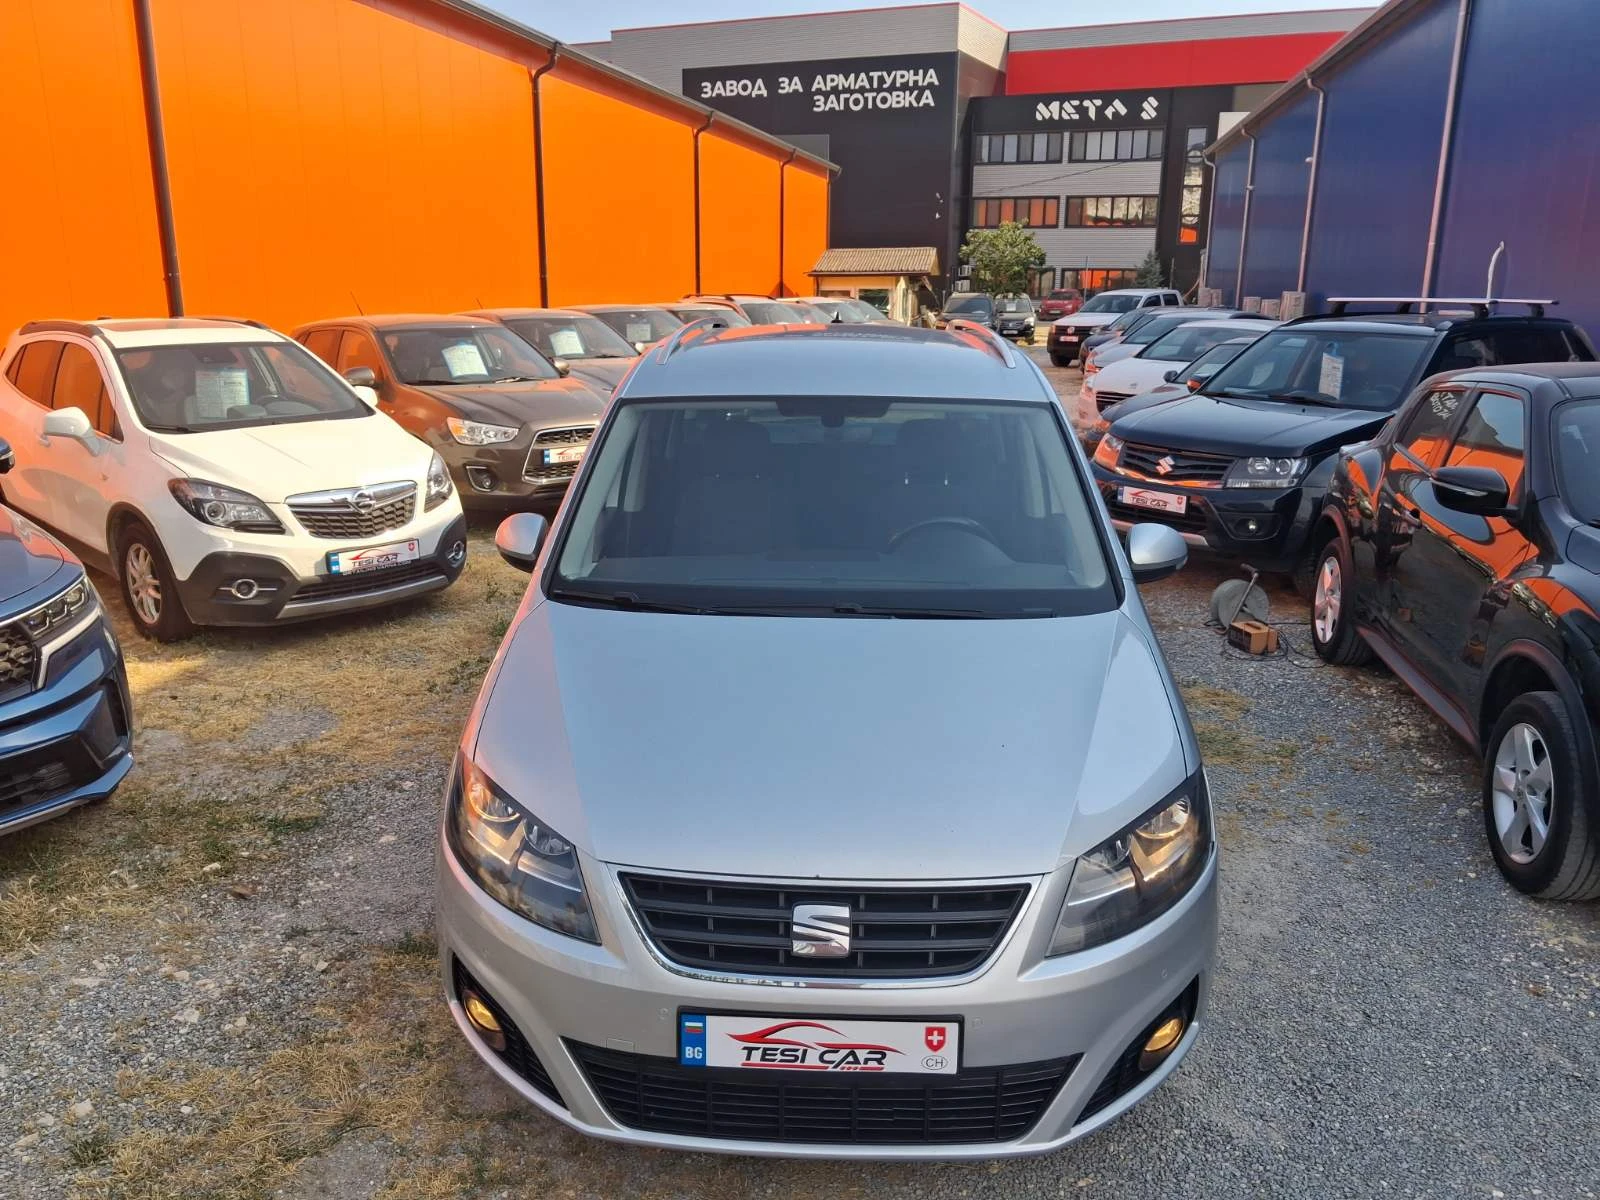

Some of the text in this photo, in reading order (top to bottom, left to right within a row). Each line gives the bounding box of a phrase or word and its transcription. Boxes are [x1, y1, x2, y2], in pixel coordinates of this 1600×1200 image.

[701, 68, 940, 98] ЗАВОД ЗА АРМАТУРНА
[813, 90, 935, 112] ЗАГОТОВКА
[1131, 496, 1148, 505] TESI
[1150, 500, 1168, 508] CAR
[352, 555, 398, 567] TESI CAR
[685, 1046, 703, 1059] BG
[741, 1046, 888, 1069] TESI CAR
[925, 1057, 944, 1068] CH
